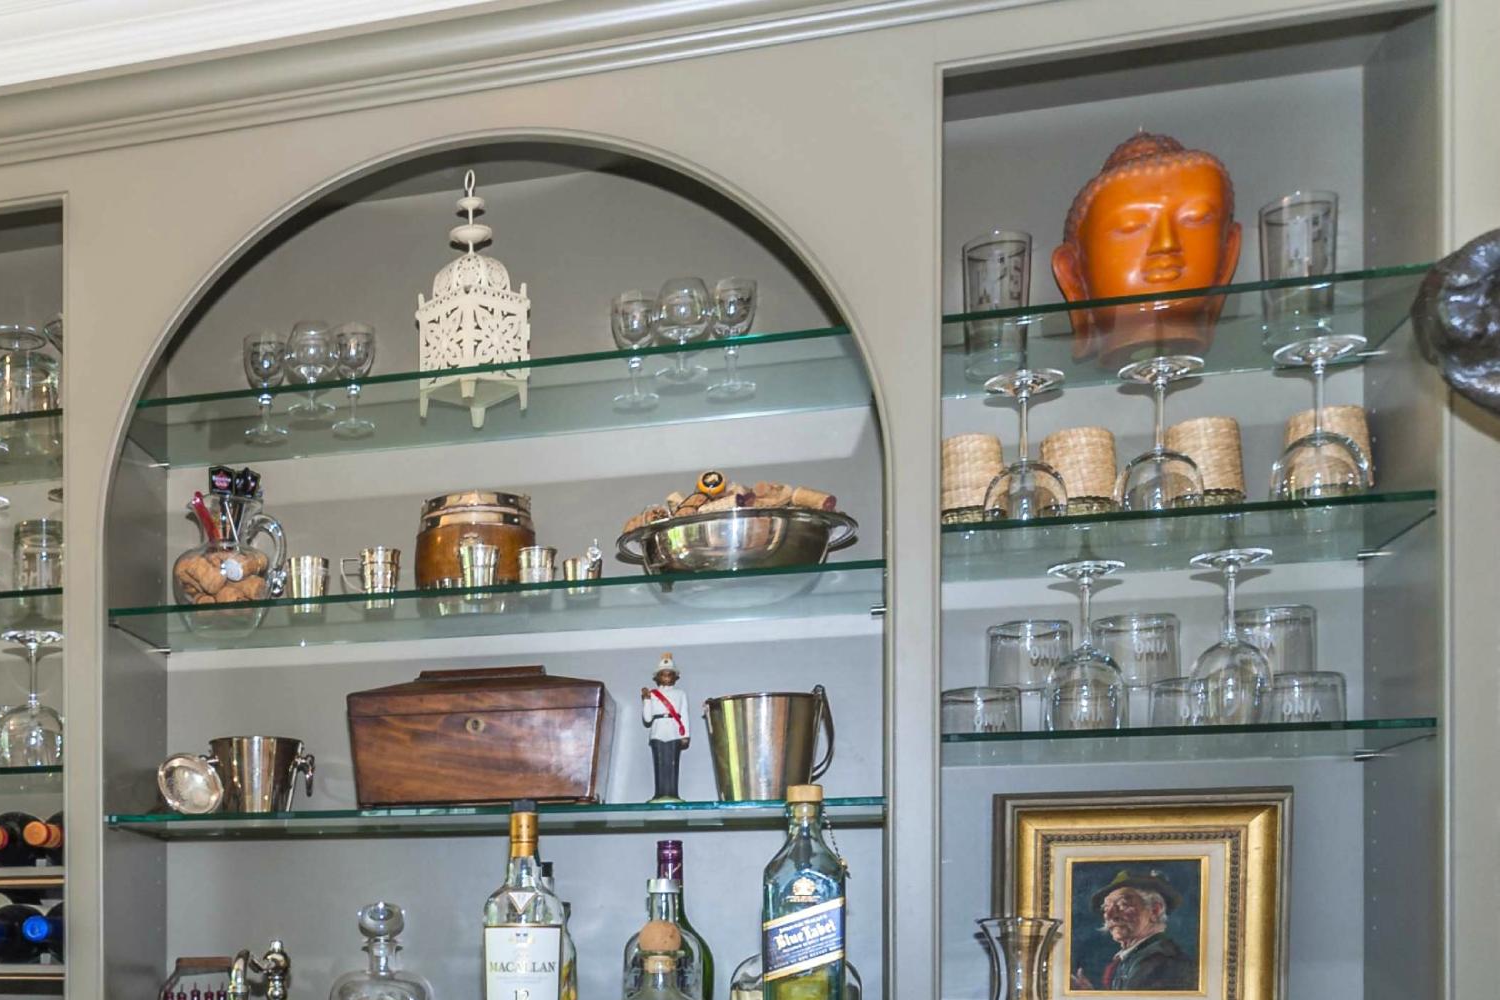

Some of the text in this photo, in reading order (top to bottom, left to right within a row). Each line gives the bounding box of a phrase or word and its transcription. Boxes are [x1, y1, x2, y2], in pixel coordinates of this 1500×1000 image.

[1030, 646, 1061, 659] VINO
[1135, 639, 1168, 653] VINO
[1283, 700, 1321, 714] VINO
[774, 932, 804, 950] Blue
[802, 919, 836, 940] Label
